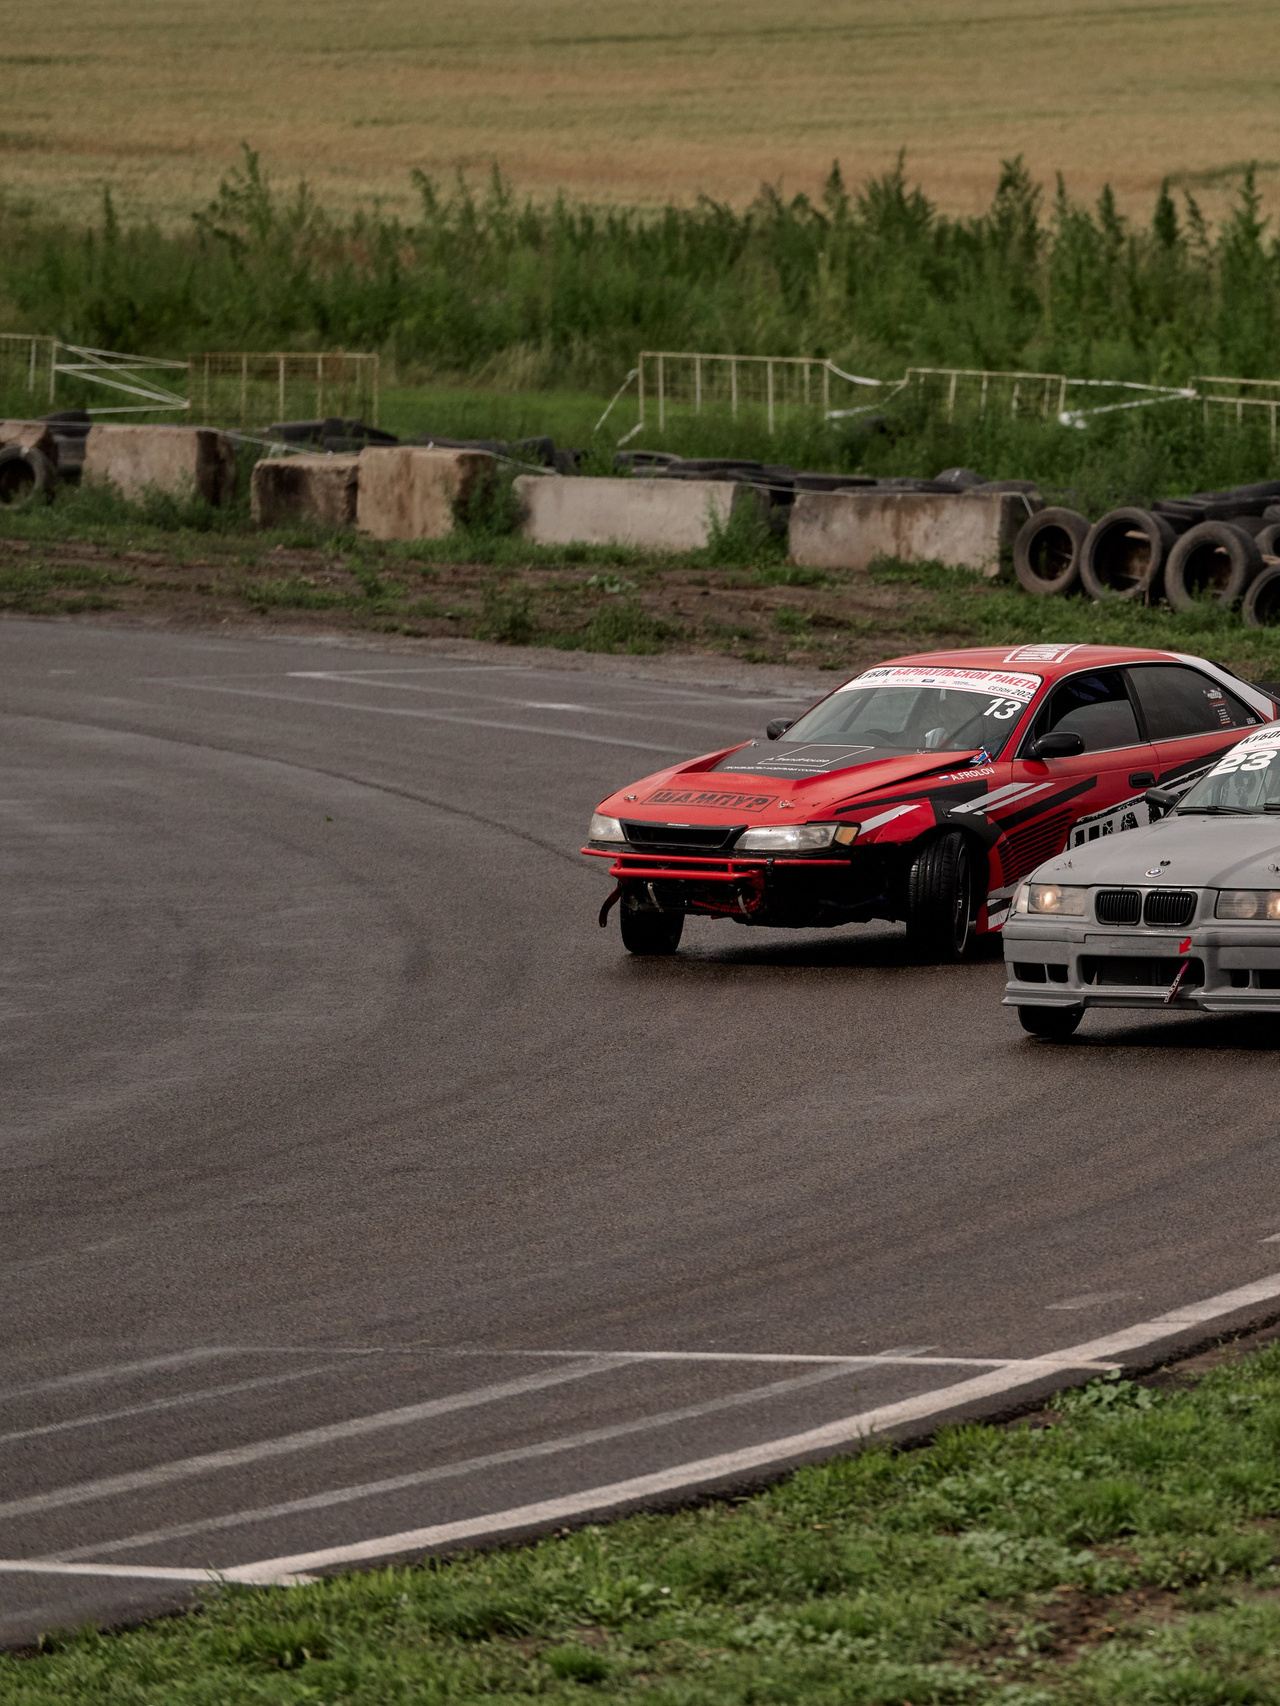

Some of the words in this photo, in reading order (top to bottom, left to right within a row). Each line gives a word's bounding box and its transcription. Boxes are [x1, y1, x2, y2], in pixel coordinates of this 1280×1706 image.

[892, 668, 991, 681] БАРНАУЛЬСКОЙ
[983, 697, 1022, 719] 13
[1207, 750, 1278, 778] 23
[950, 767, 995, 781] A.FROLOV
[648, 791, 769, 808] ШАМПУР
